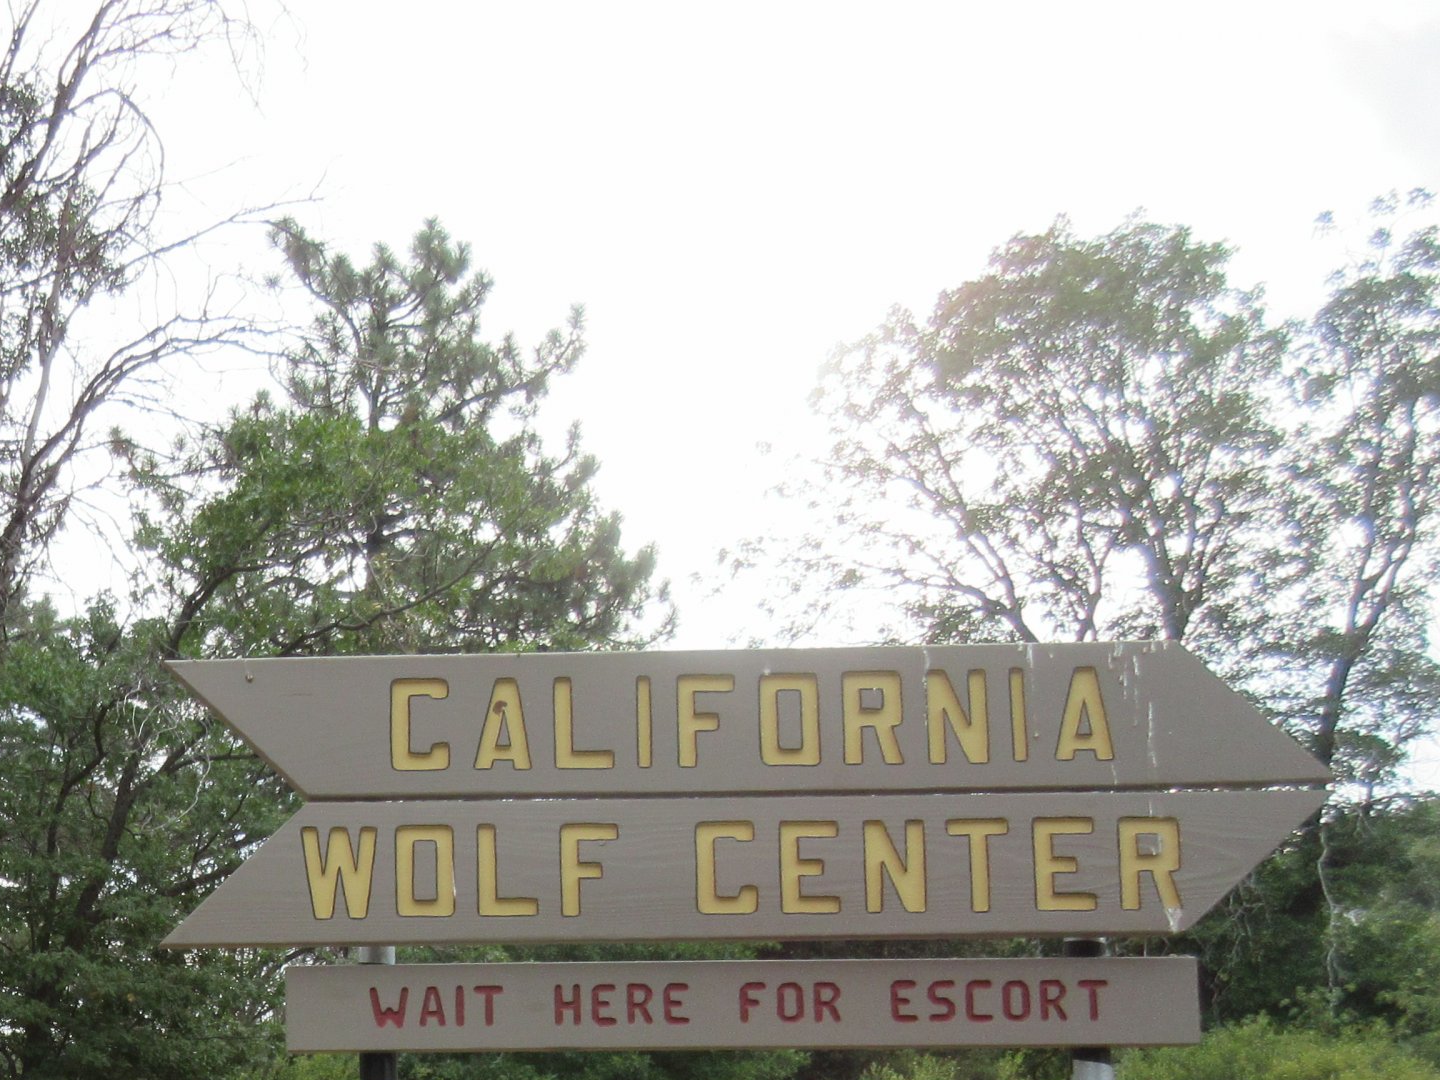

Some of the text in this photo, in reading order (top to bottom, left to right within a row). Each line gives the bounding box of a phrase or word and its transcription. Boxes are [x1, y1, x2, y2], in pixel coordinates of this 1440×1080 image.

[389, 665, 1115, 772] CALIFORNIA
[299, 814, 1184, 920] WOLF CENTER
[368, 977, 1110, 1029] WAIT HERE FOR ESCORT
